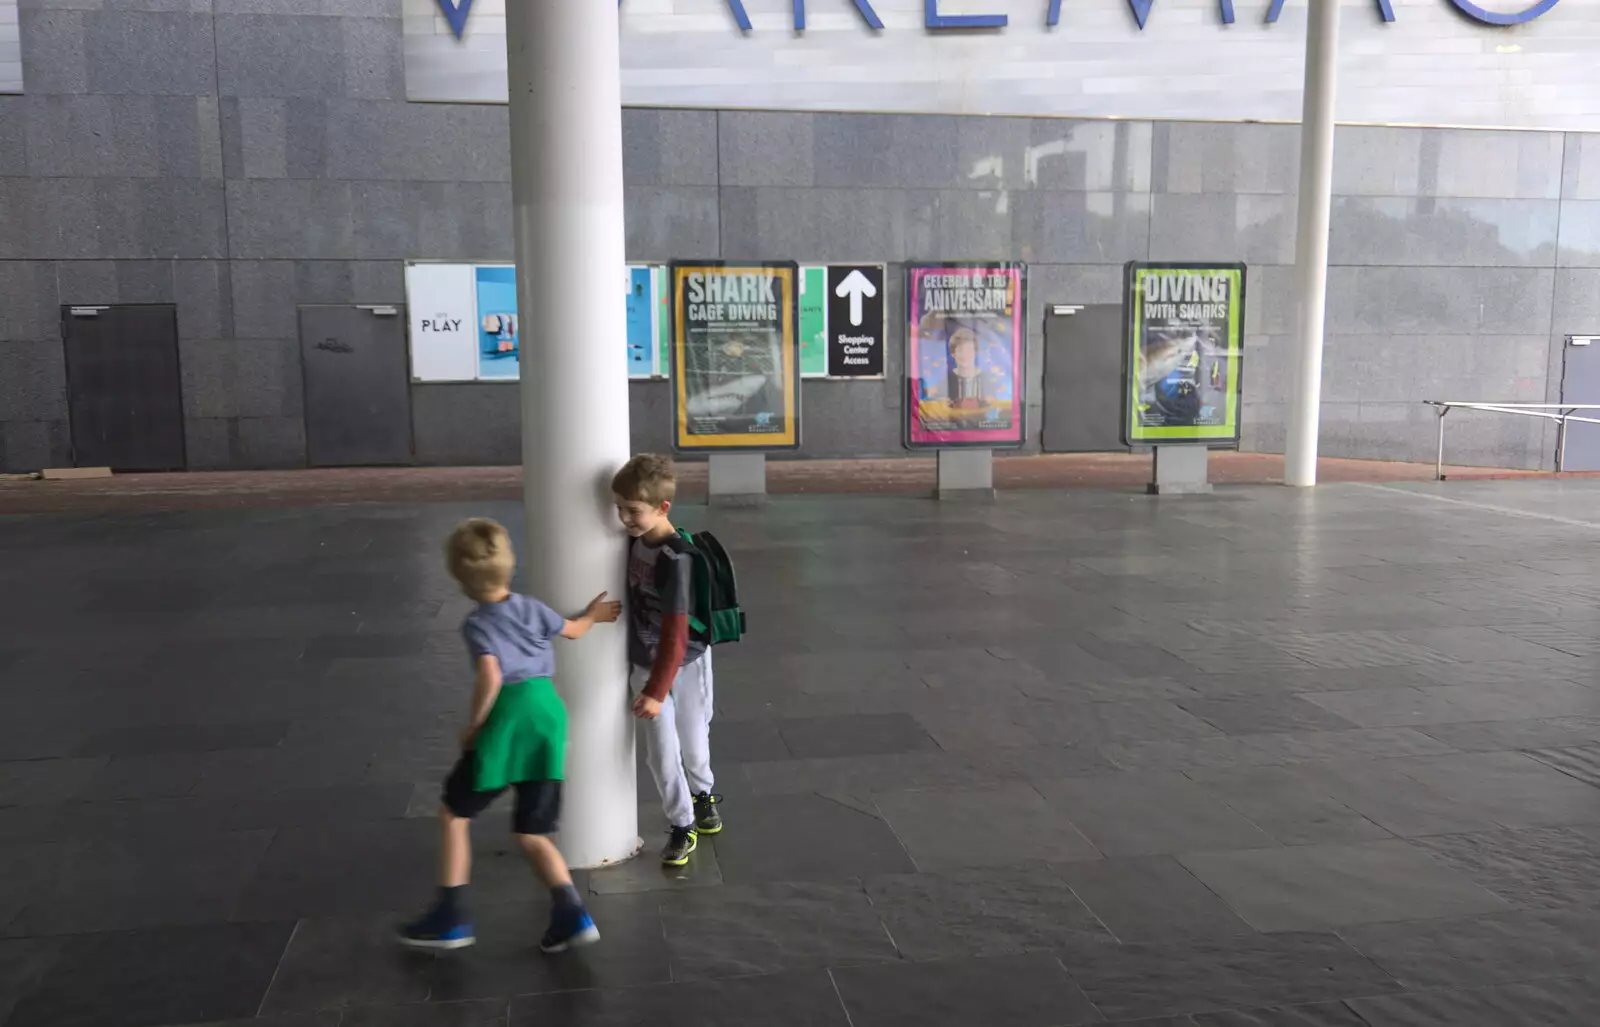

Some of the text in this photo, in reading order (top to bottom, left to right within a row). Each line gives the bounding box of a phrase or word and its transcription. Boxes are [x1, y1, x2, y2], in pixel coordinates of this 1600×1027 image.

[687, 271, 776, 303] SHARK
[923, 274, 970, 289] CELEBRA
[1144, 273, 1227, 302] DIVING
[923, 288, 1007, 310] ANIVERSARI
[688, 303, 777, 321] CAGE DIVING
[1144, 303, 1227, 319] WITH SHARKS
[421, 319, 462, 332] PLAY
[838, 334, 875, 346] Shopping
[843, 345, 869, 355] Center
[843, 355, 870, 365] Access
